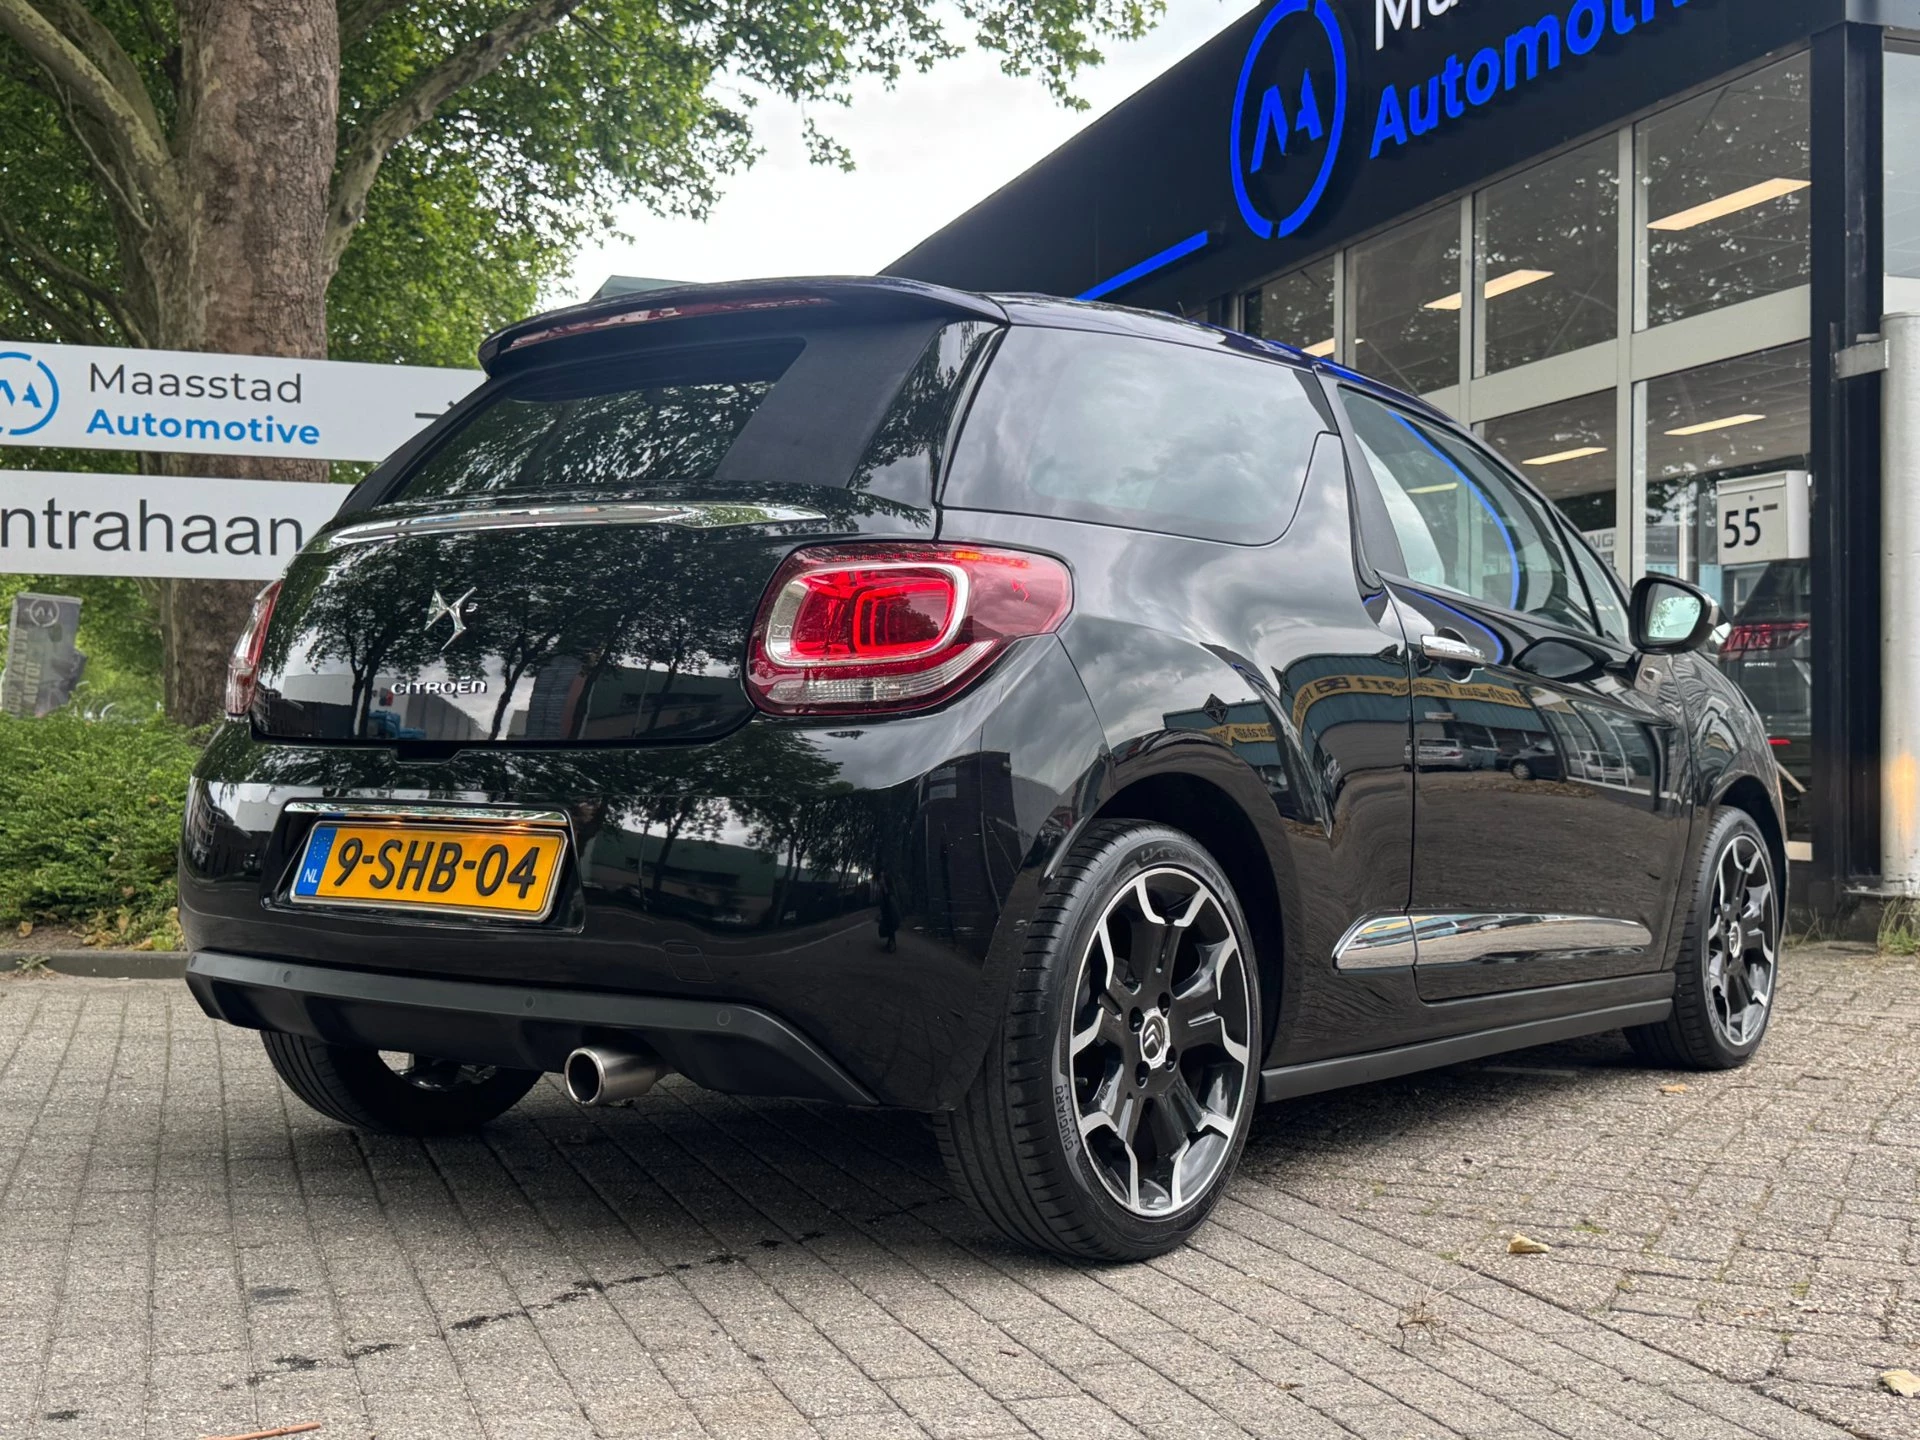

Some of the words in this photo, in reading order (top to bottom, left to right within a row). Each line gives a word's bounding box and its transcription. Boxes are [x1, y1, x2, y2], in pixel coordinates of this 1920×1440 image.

[90, 362, 302, 404] Maasstad
[86, 408, 320, 445] Automotive
[0, 497, 303, 556] ntrahaan
[1724, 507, 1761, 549] 55
[303, 868, 318, 883] NL
[334, 837, 540, 899] 9-SHB-04
[1055, 1085, 1074, 1151] GIUGIARO
